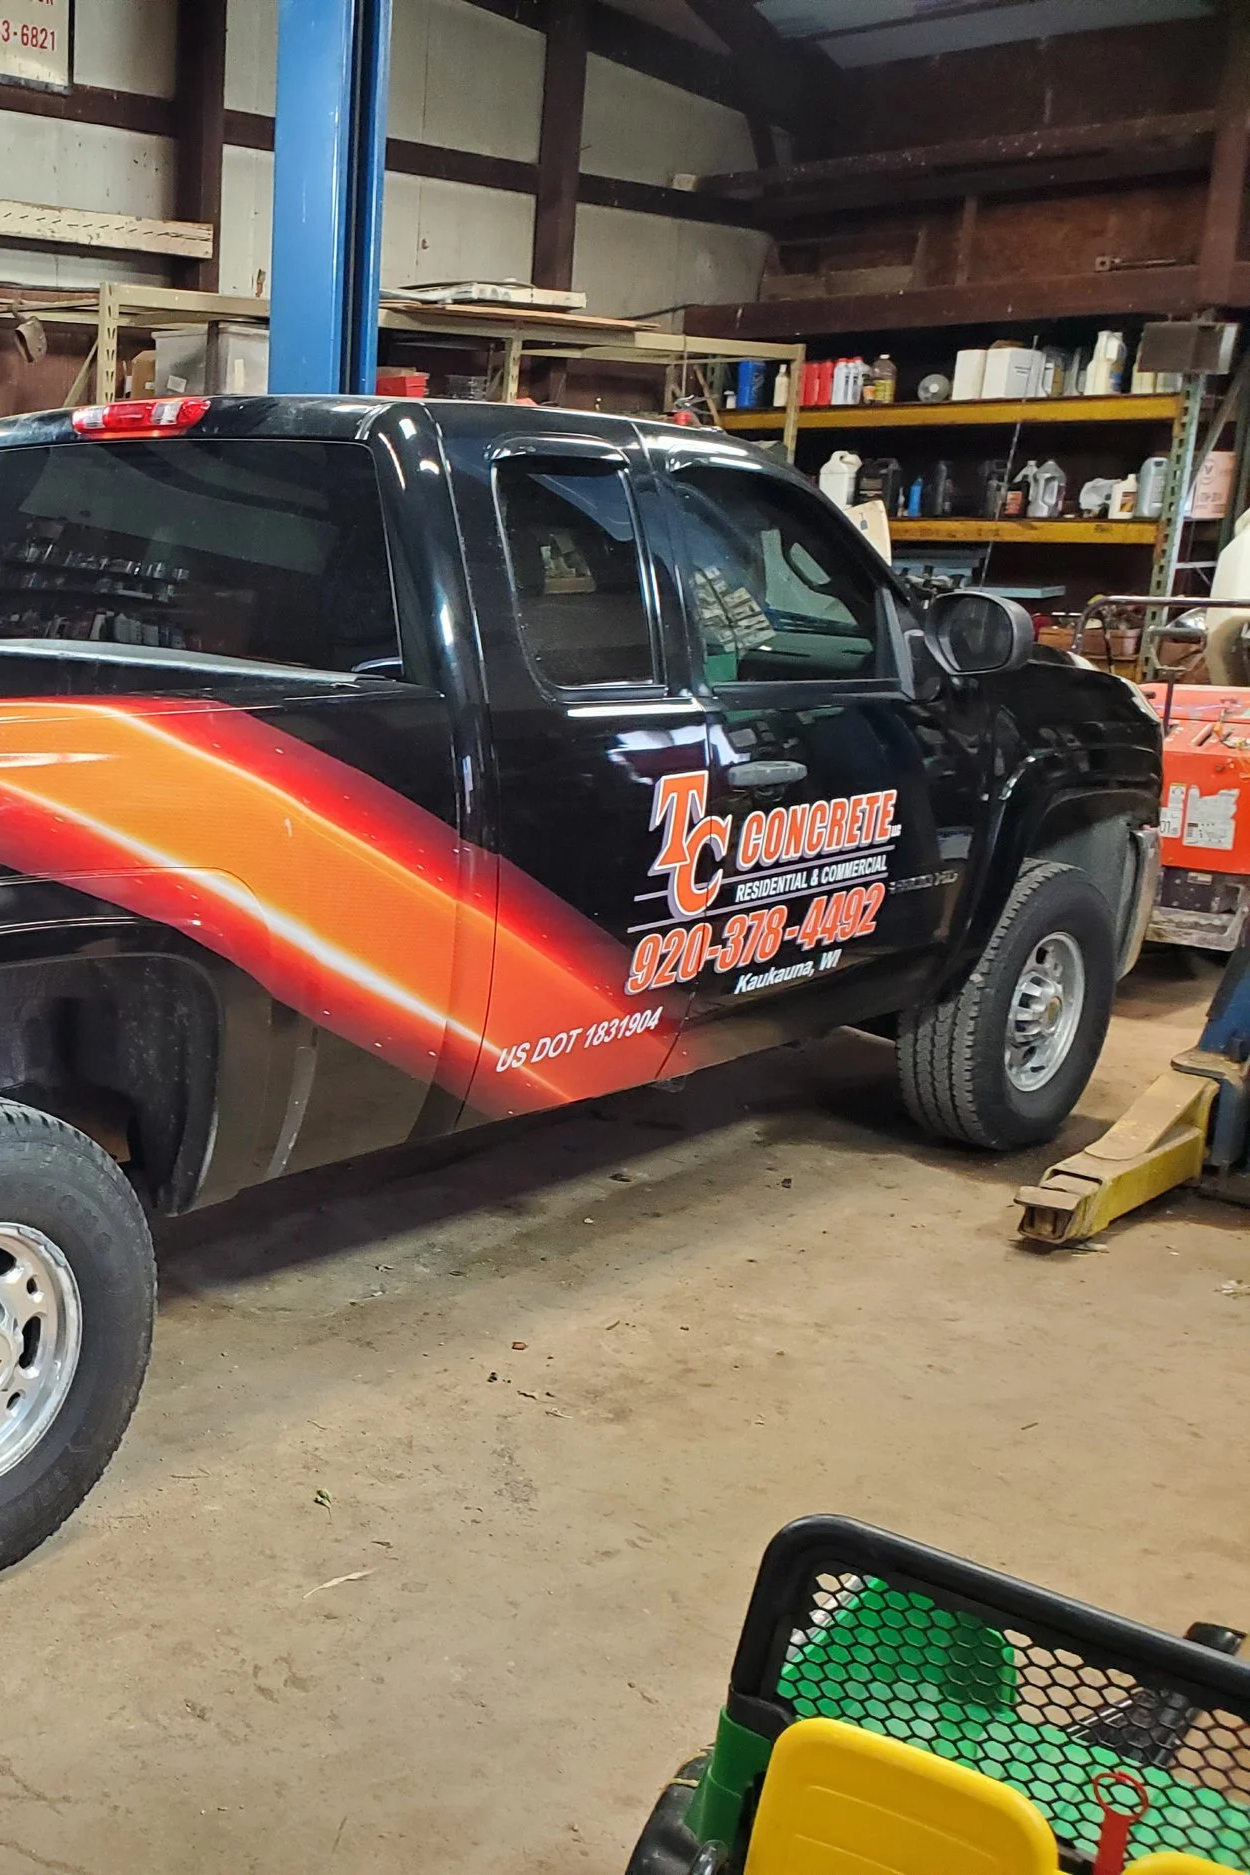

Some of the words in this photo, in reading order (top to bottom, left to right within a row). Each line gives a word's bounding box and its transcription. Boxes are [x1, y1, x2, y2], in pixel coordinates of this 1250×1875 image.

[737, 789, 899, 871] CONCRETE
[735, 871, 808, 903] RESIDENTIAL
[809, 869, 819, 888] &
[820, 854, 888, 884] COMMERCIAL
[625, 882, 887, 997] 920-378-4492
[734, 962, 816, 995] Kaukauna,
[812, 947, 843, 974] WI
[496, 1043, 528, 1074] US
[530, 1028, 583, 1066] DOT
[582, 1006, 664, 1051] 1831904
